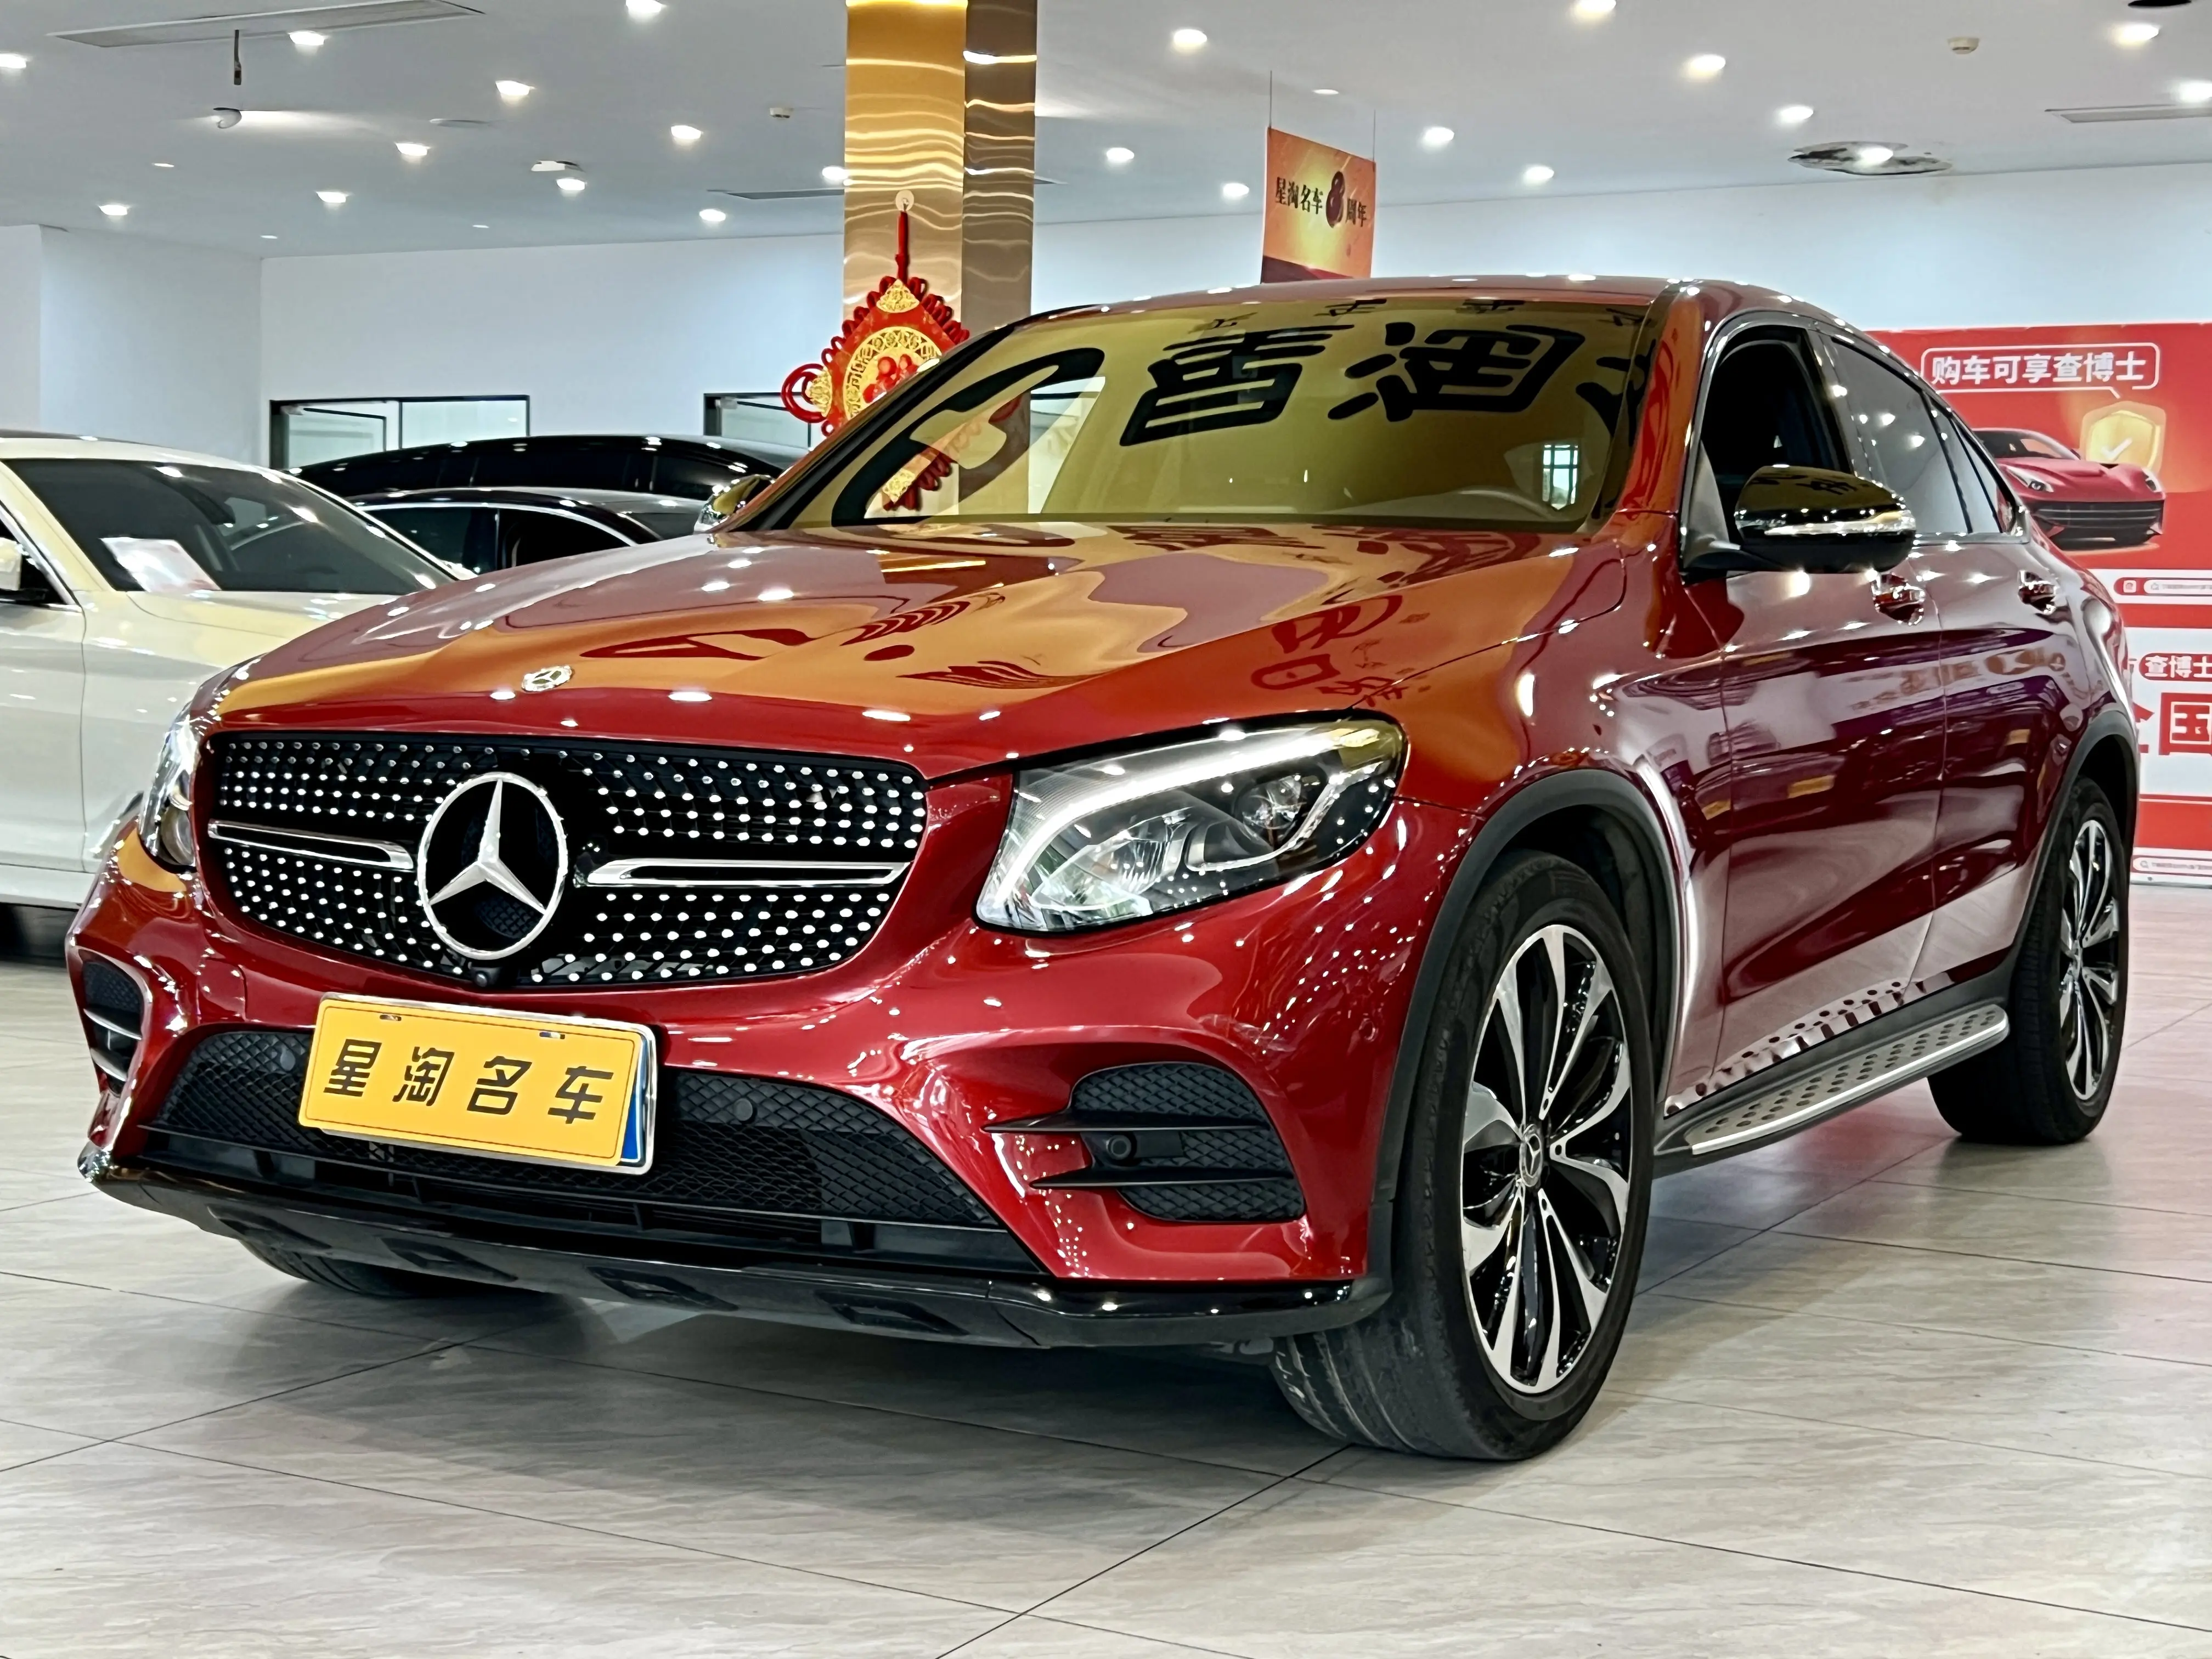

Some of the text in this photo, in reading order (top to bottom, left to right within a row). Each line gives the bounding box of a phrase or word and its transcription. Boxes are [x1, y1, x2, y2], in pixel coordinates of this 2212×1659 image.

[1931, 351, 2146, 385] 购车可享查博士
[2143, 654, 2212, 679] 查博士
[323, 1038, 614, 1125] 星淘名车
